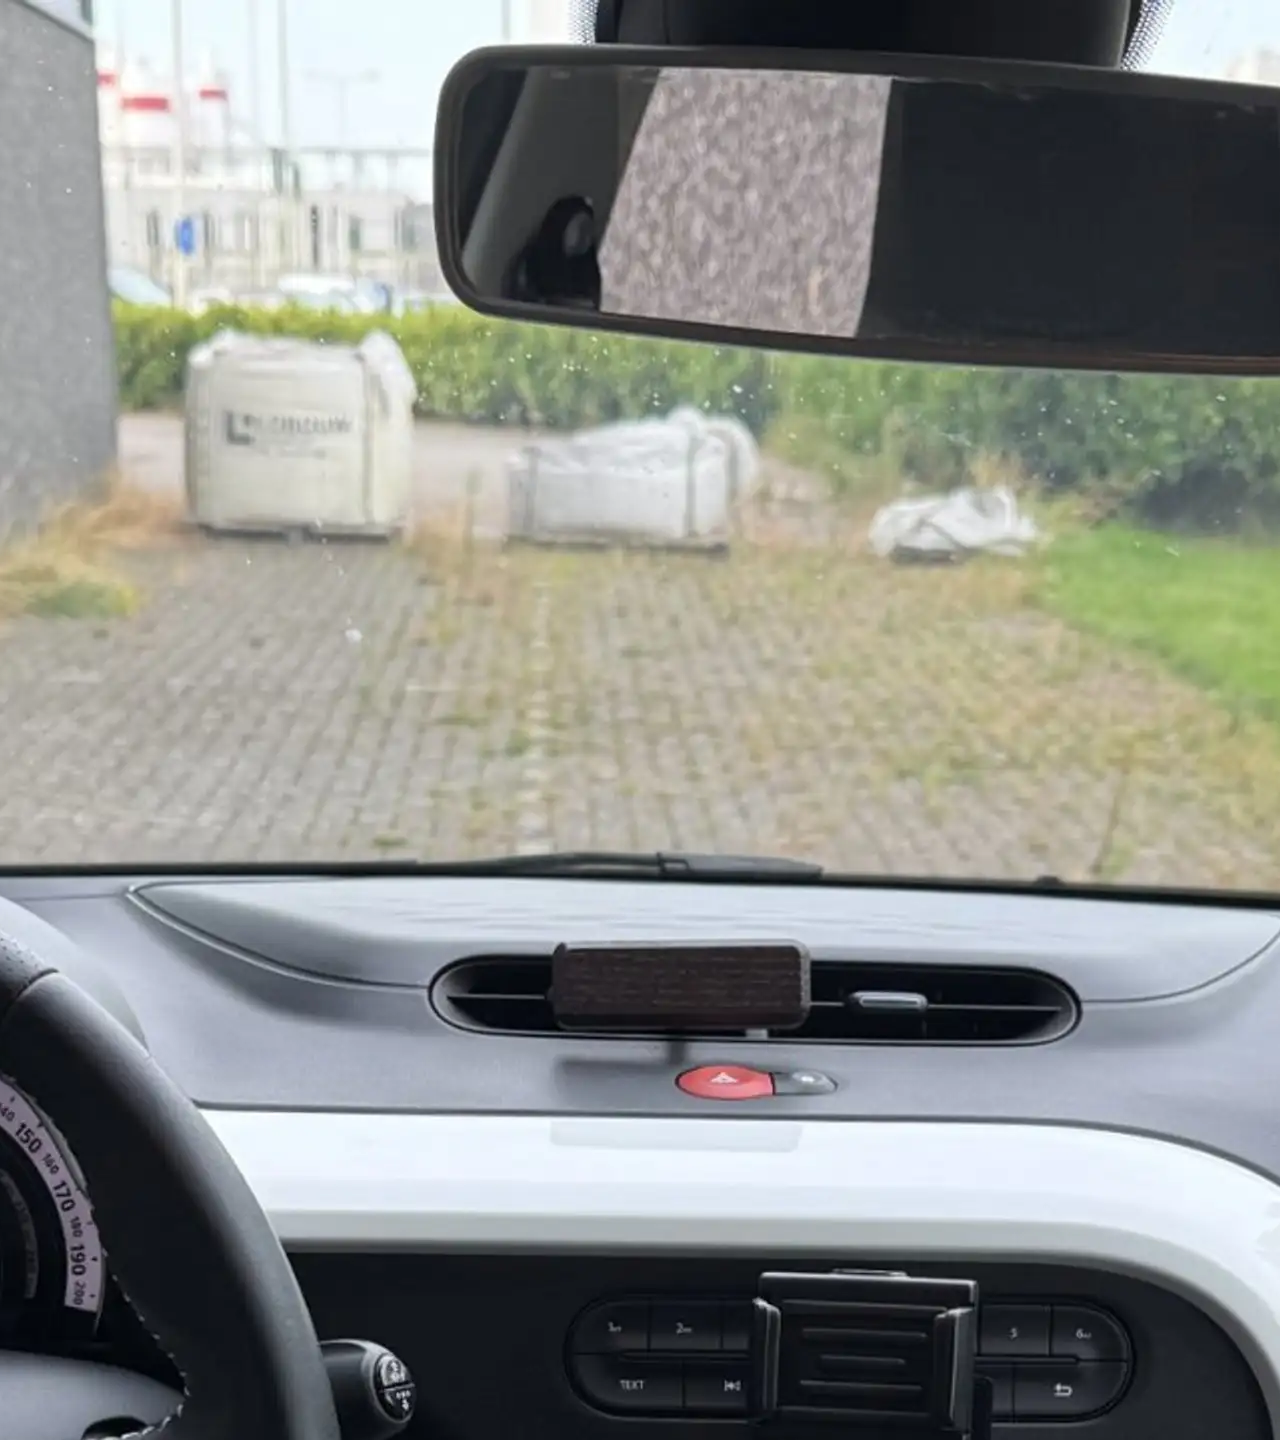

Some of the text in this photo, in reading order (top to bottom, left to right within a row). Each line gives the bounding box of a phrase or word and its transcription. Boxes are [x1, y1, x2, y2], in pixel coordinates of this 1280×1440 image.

[15, 1122, 42, 1154] 150
[53, 1180, 76, 1212] 170
[70, 1244, 87, 1276] 190
[73, 1281, 87, 1305] 200
[619, 1379, 646, 1391] TEXT
